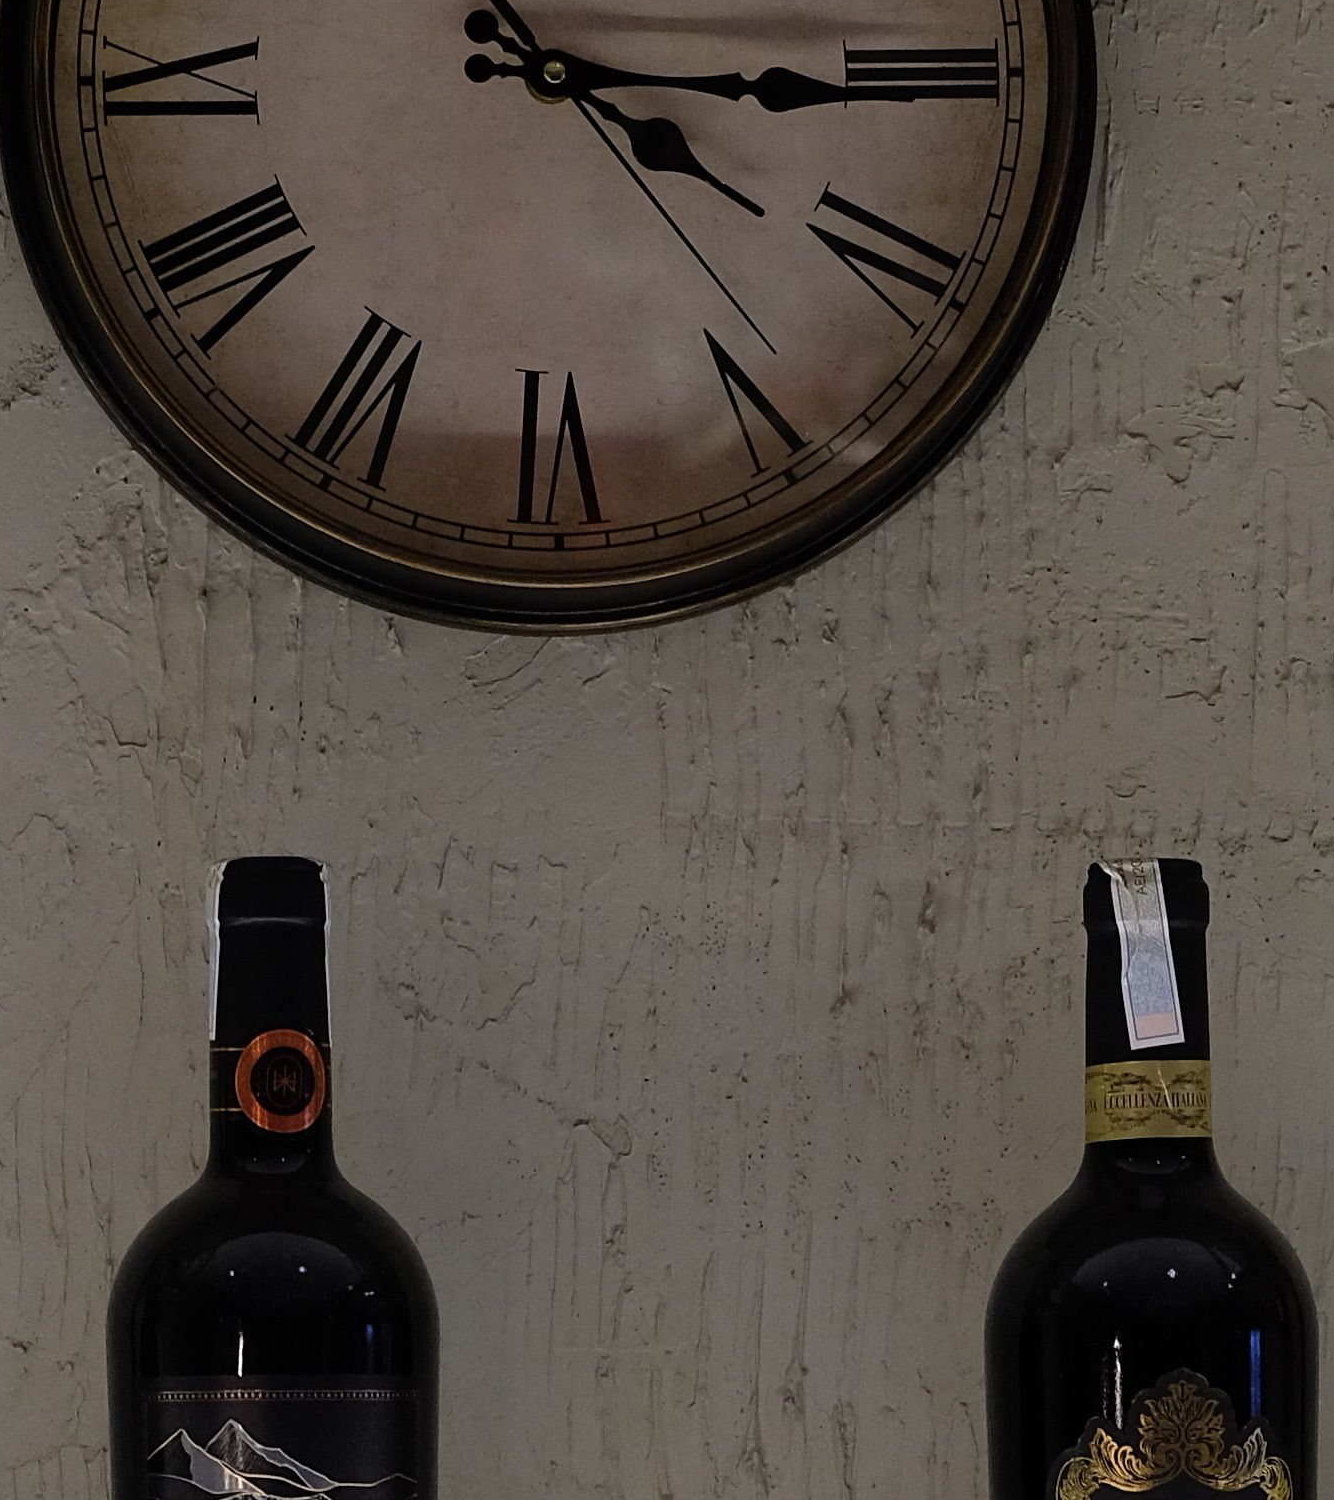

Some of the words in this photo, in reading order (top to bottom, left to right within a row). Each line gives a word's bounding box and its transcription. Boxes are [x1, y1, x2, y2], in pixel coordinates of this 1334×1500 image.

[103, 36, 261, 124] IX
[844, 39, 1001, 108] III
[138, 174, 317, 358] VIII
[806, 182, 967, 338] IV
[286, 306, 424, 491] VII
[506, 369, 608, 527] VI
[704, 326, 814, 478] V
